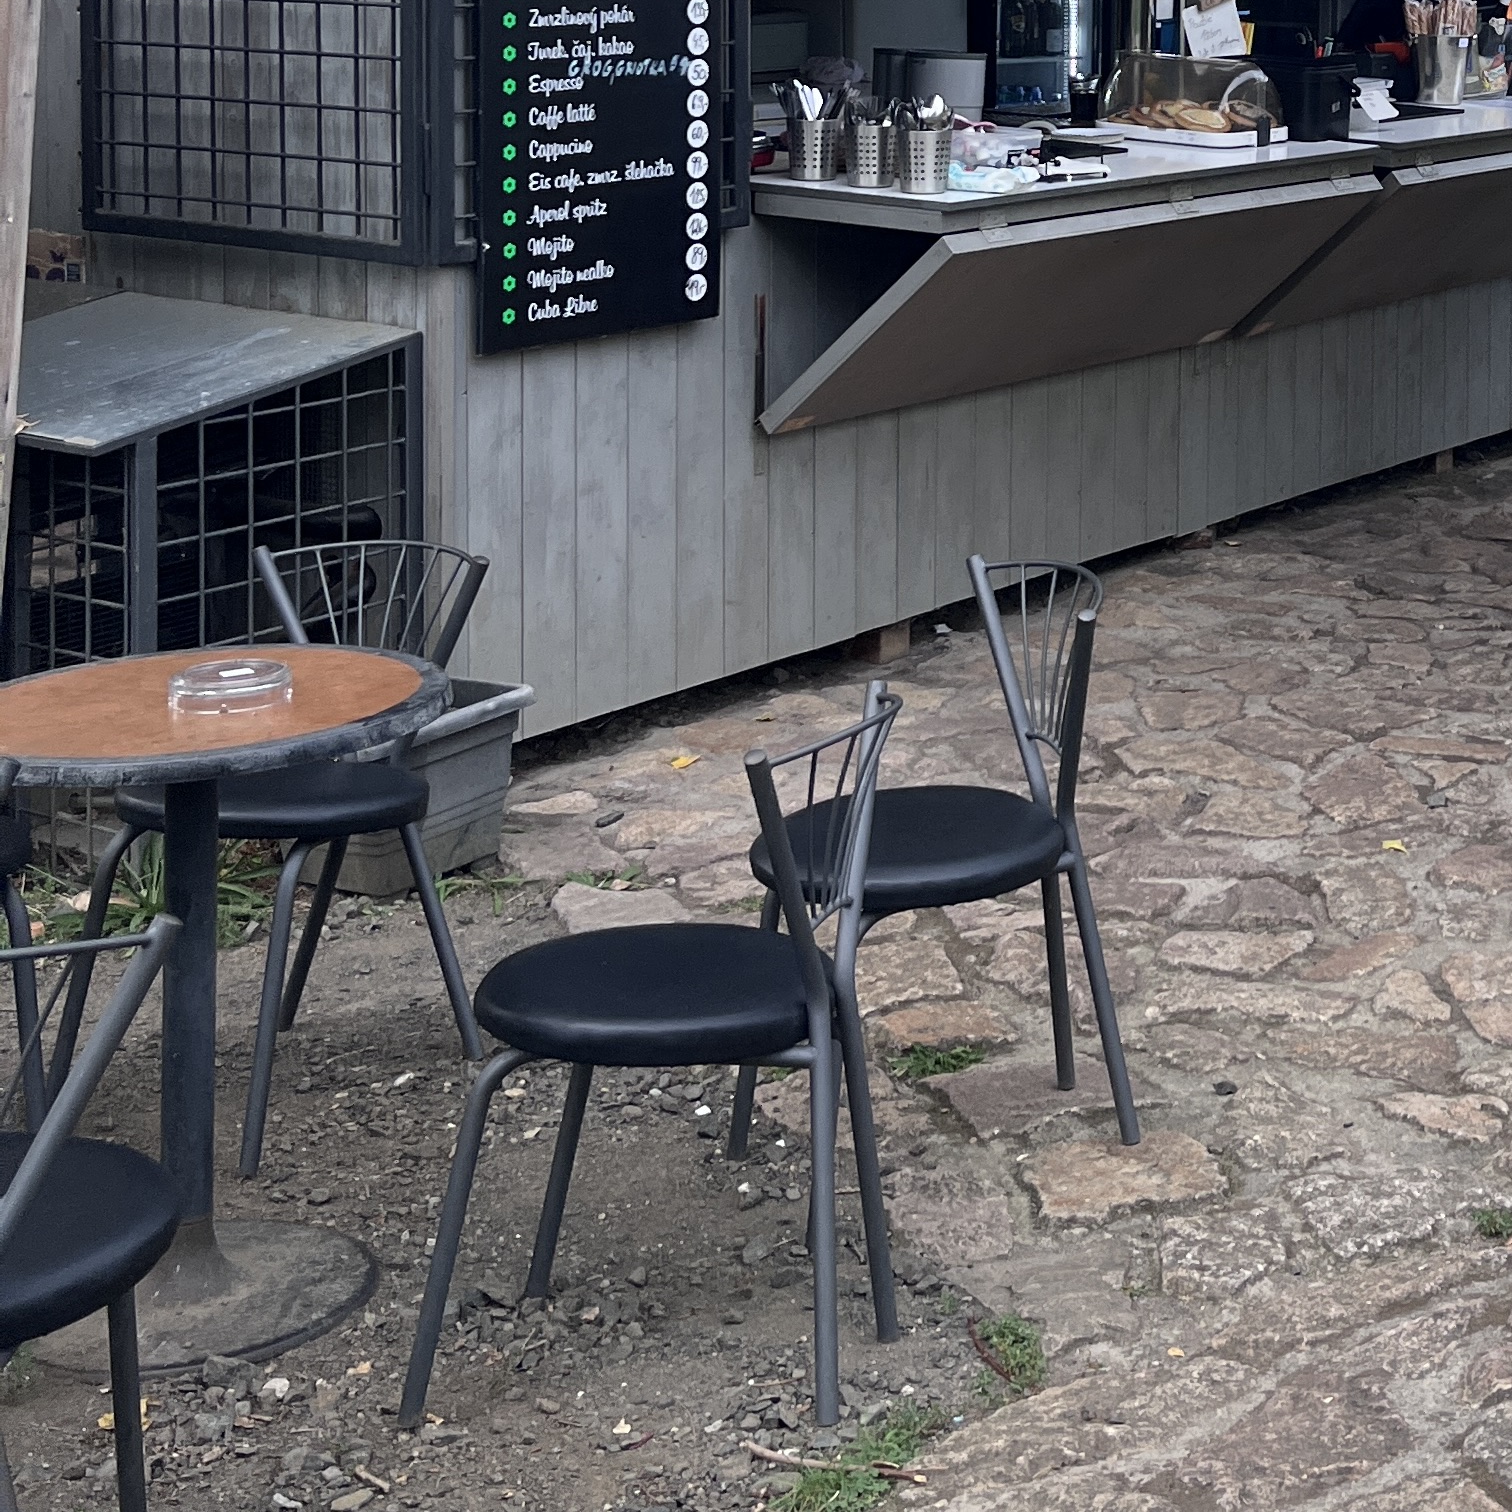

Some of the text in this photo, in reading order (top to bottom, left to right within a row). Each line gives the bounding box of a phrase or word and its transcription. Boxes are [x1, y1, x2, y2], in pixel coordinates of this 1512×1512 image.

[528, 4, 635, 33] Zmrzlinový pohár
[598, 35, 635, 56] kakao
[528, 74, 584, 97] Espresso
[528, 105, 565, 130] Caffe
[528, 139, 594, 162] Cappucino
[528, 172, 552, 191] Eis
[624, 157, 675, 181] šlehačka
[526, 198, 608, 228] Aperol spritz
[527, 234, 575, 261] Mojito
[527, 259, 615, 293] Mojito nealko
[528, 294, 598, 322] Cuba Libre
